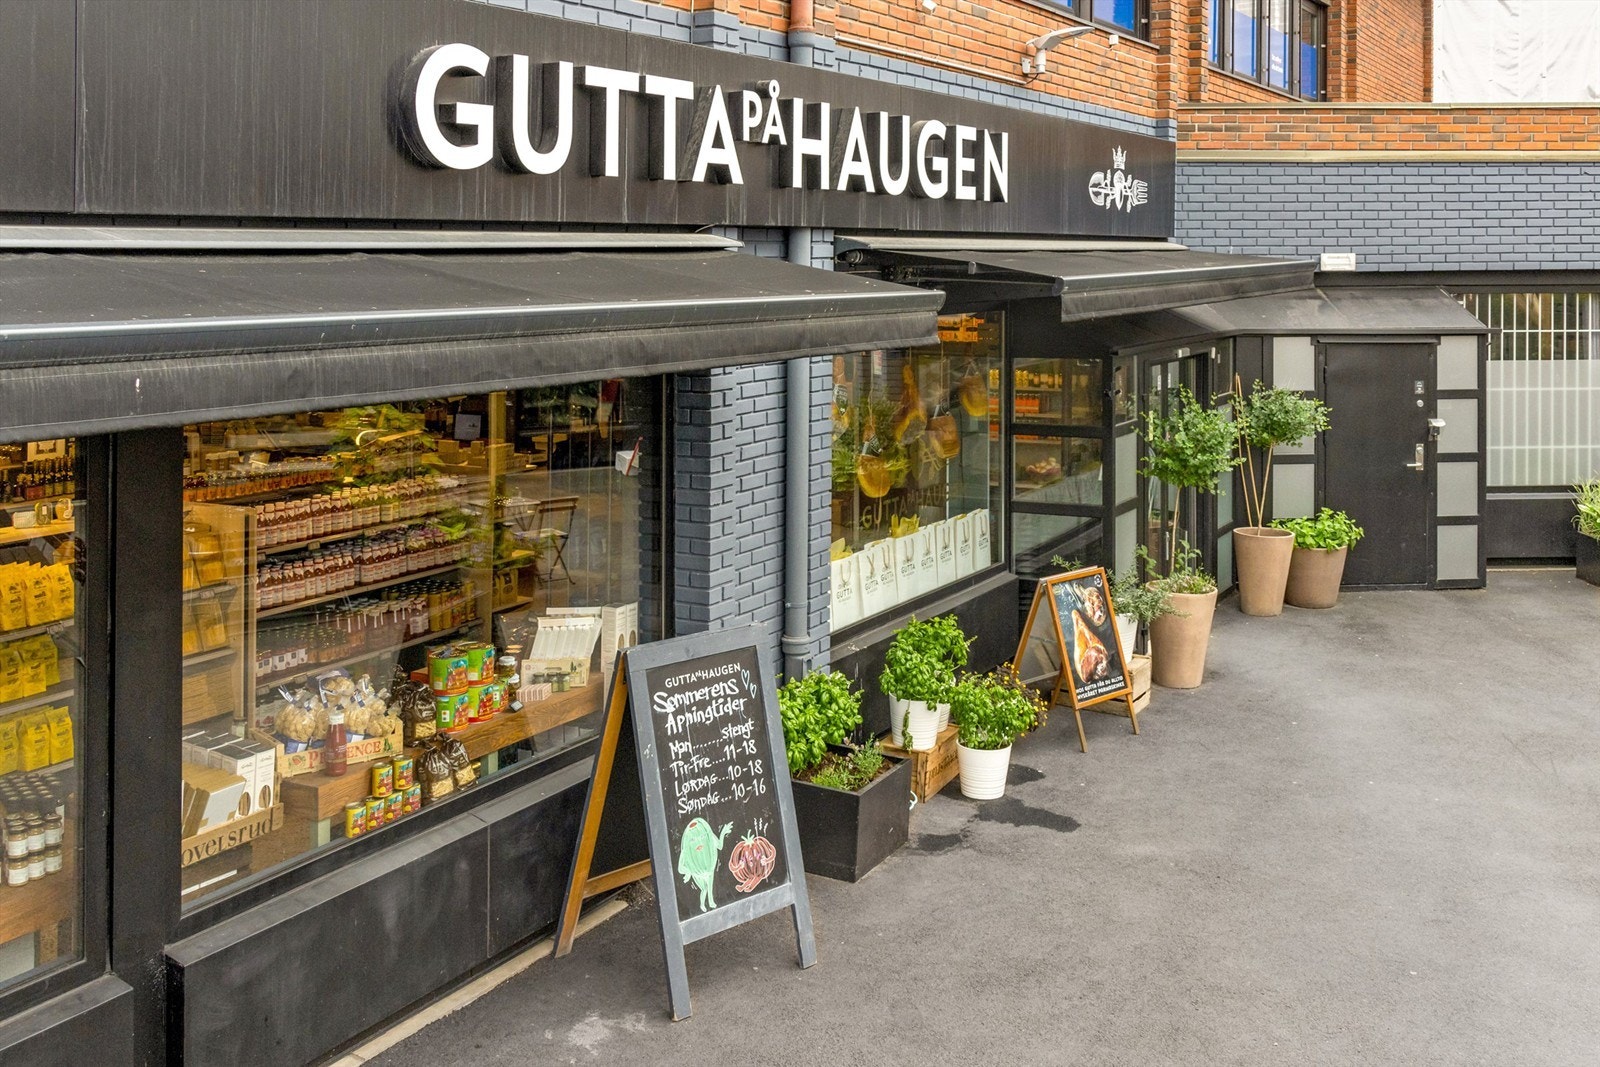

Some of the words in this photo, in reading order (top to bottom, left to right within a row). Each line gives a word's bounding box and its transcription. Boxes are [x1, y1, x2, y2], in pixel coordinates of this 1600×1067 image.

[415, 43, 744, 184] GUTTA
[743, 79, 787, 145] PÅ
[792, 97, 1009, 203] HAUGEN
[665, 672, 697, 688] GUTTA
[702, 662, 741, 680] HAUGEN
[721, 718, 755, 739] stengt
[724, 739, 757, 761] 11-18
[728, 759, 763, 781] 10-18
[731, 778, 766, 801] 10-16
